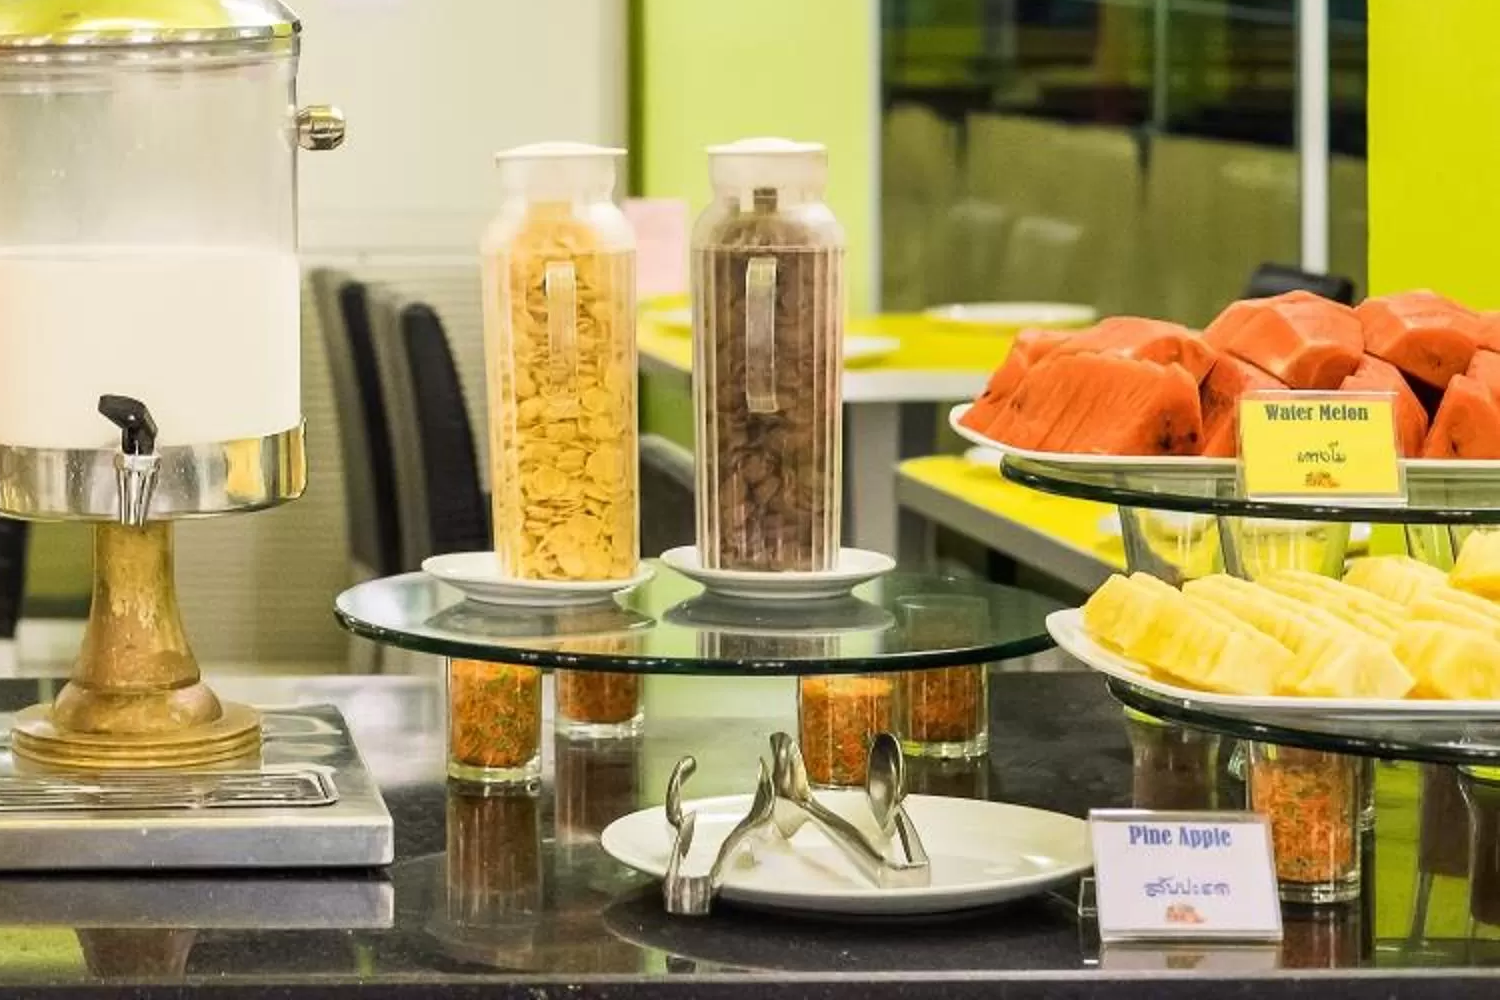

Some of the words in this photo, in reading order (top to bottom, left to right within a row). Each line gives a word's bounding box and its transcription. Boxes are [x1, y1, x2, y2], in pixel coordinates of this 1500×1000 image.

[1264, 403, 1313, 421] Water
[1319, 403, 1369, 421] Melon
[1128, 824, 1173, 846] Pine
[1179, 825, 1233, 849] Apple
